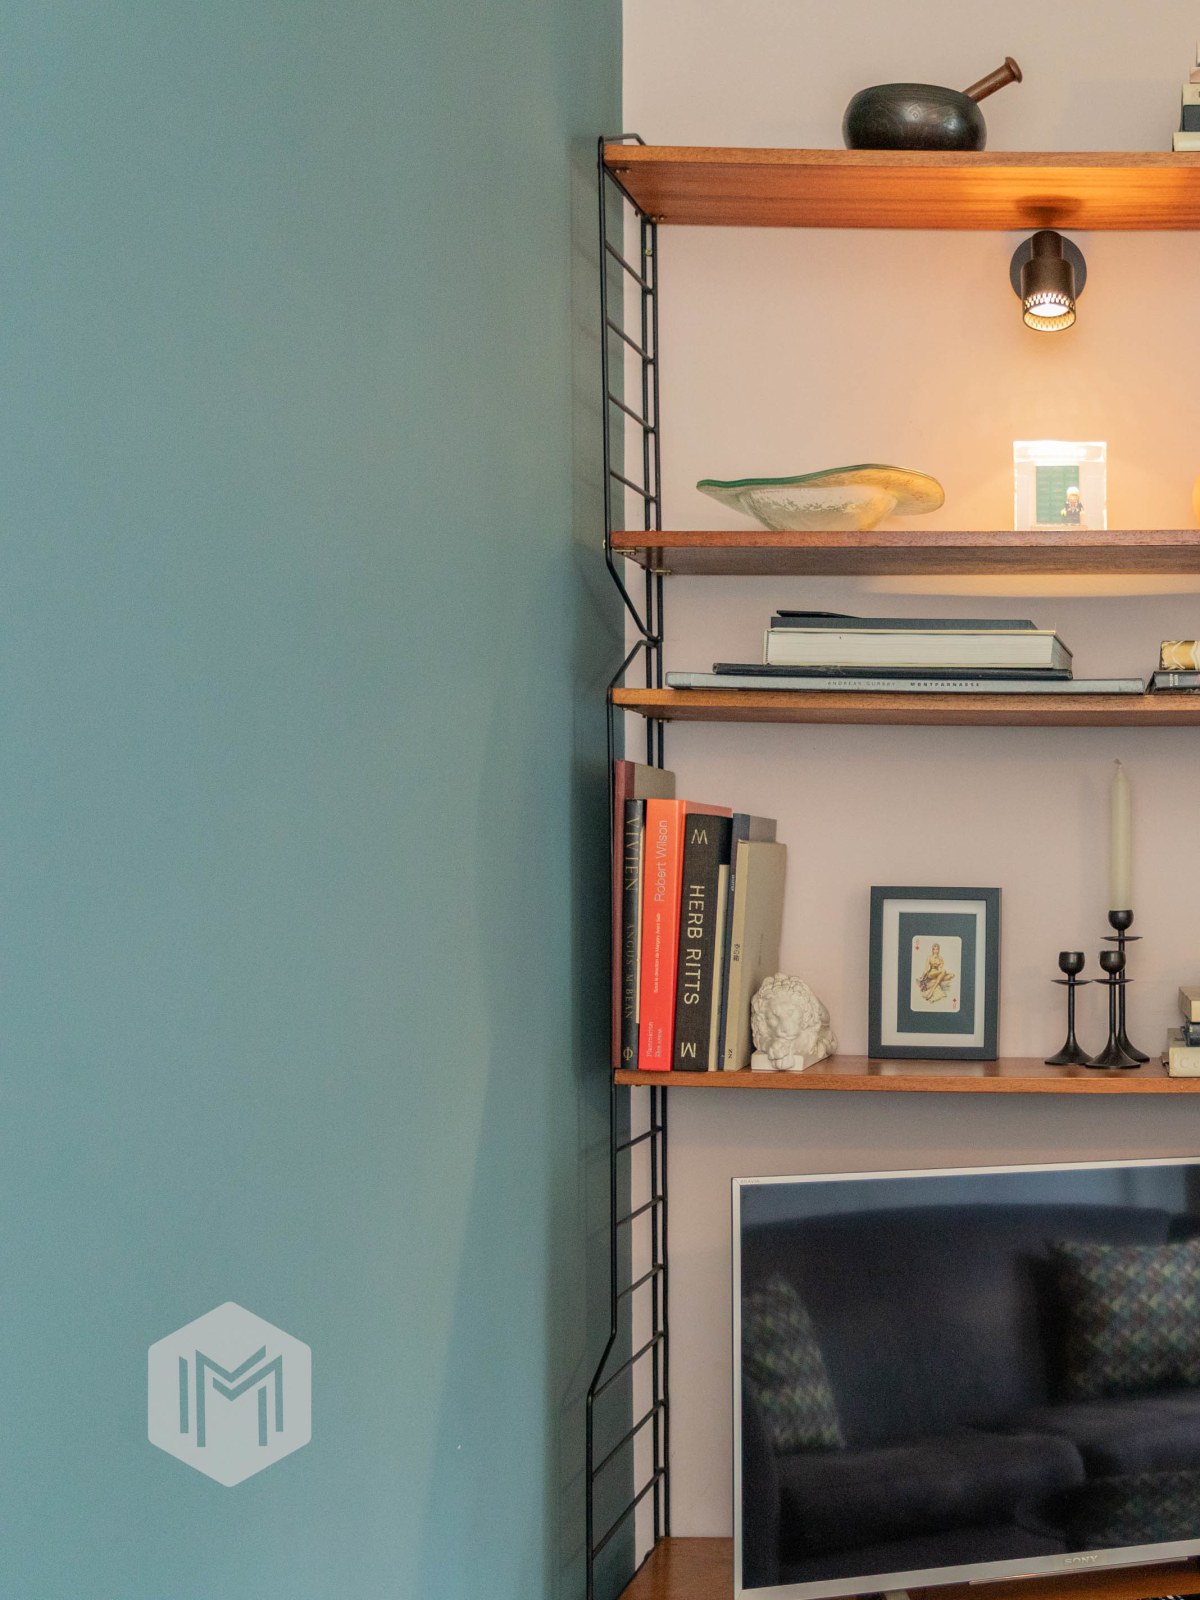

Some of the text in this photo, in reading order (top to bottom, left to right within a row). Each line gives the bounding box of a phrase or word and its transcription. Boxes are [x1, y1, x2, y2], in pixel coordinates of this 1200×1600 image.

[624, 817, 640, 892] VIVIEN
[653, 819, 668, 903] Robert Wilson
[687, 885, 705, 939] HERB
[626, 923, 636, 965] ANGUS
[683, 949, 702, 1005] RITTS
[1064, 1554, 1098, 1564] SONY
